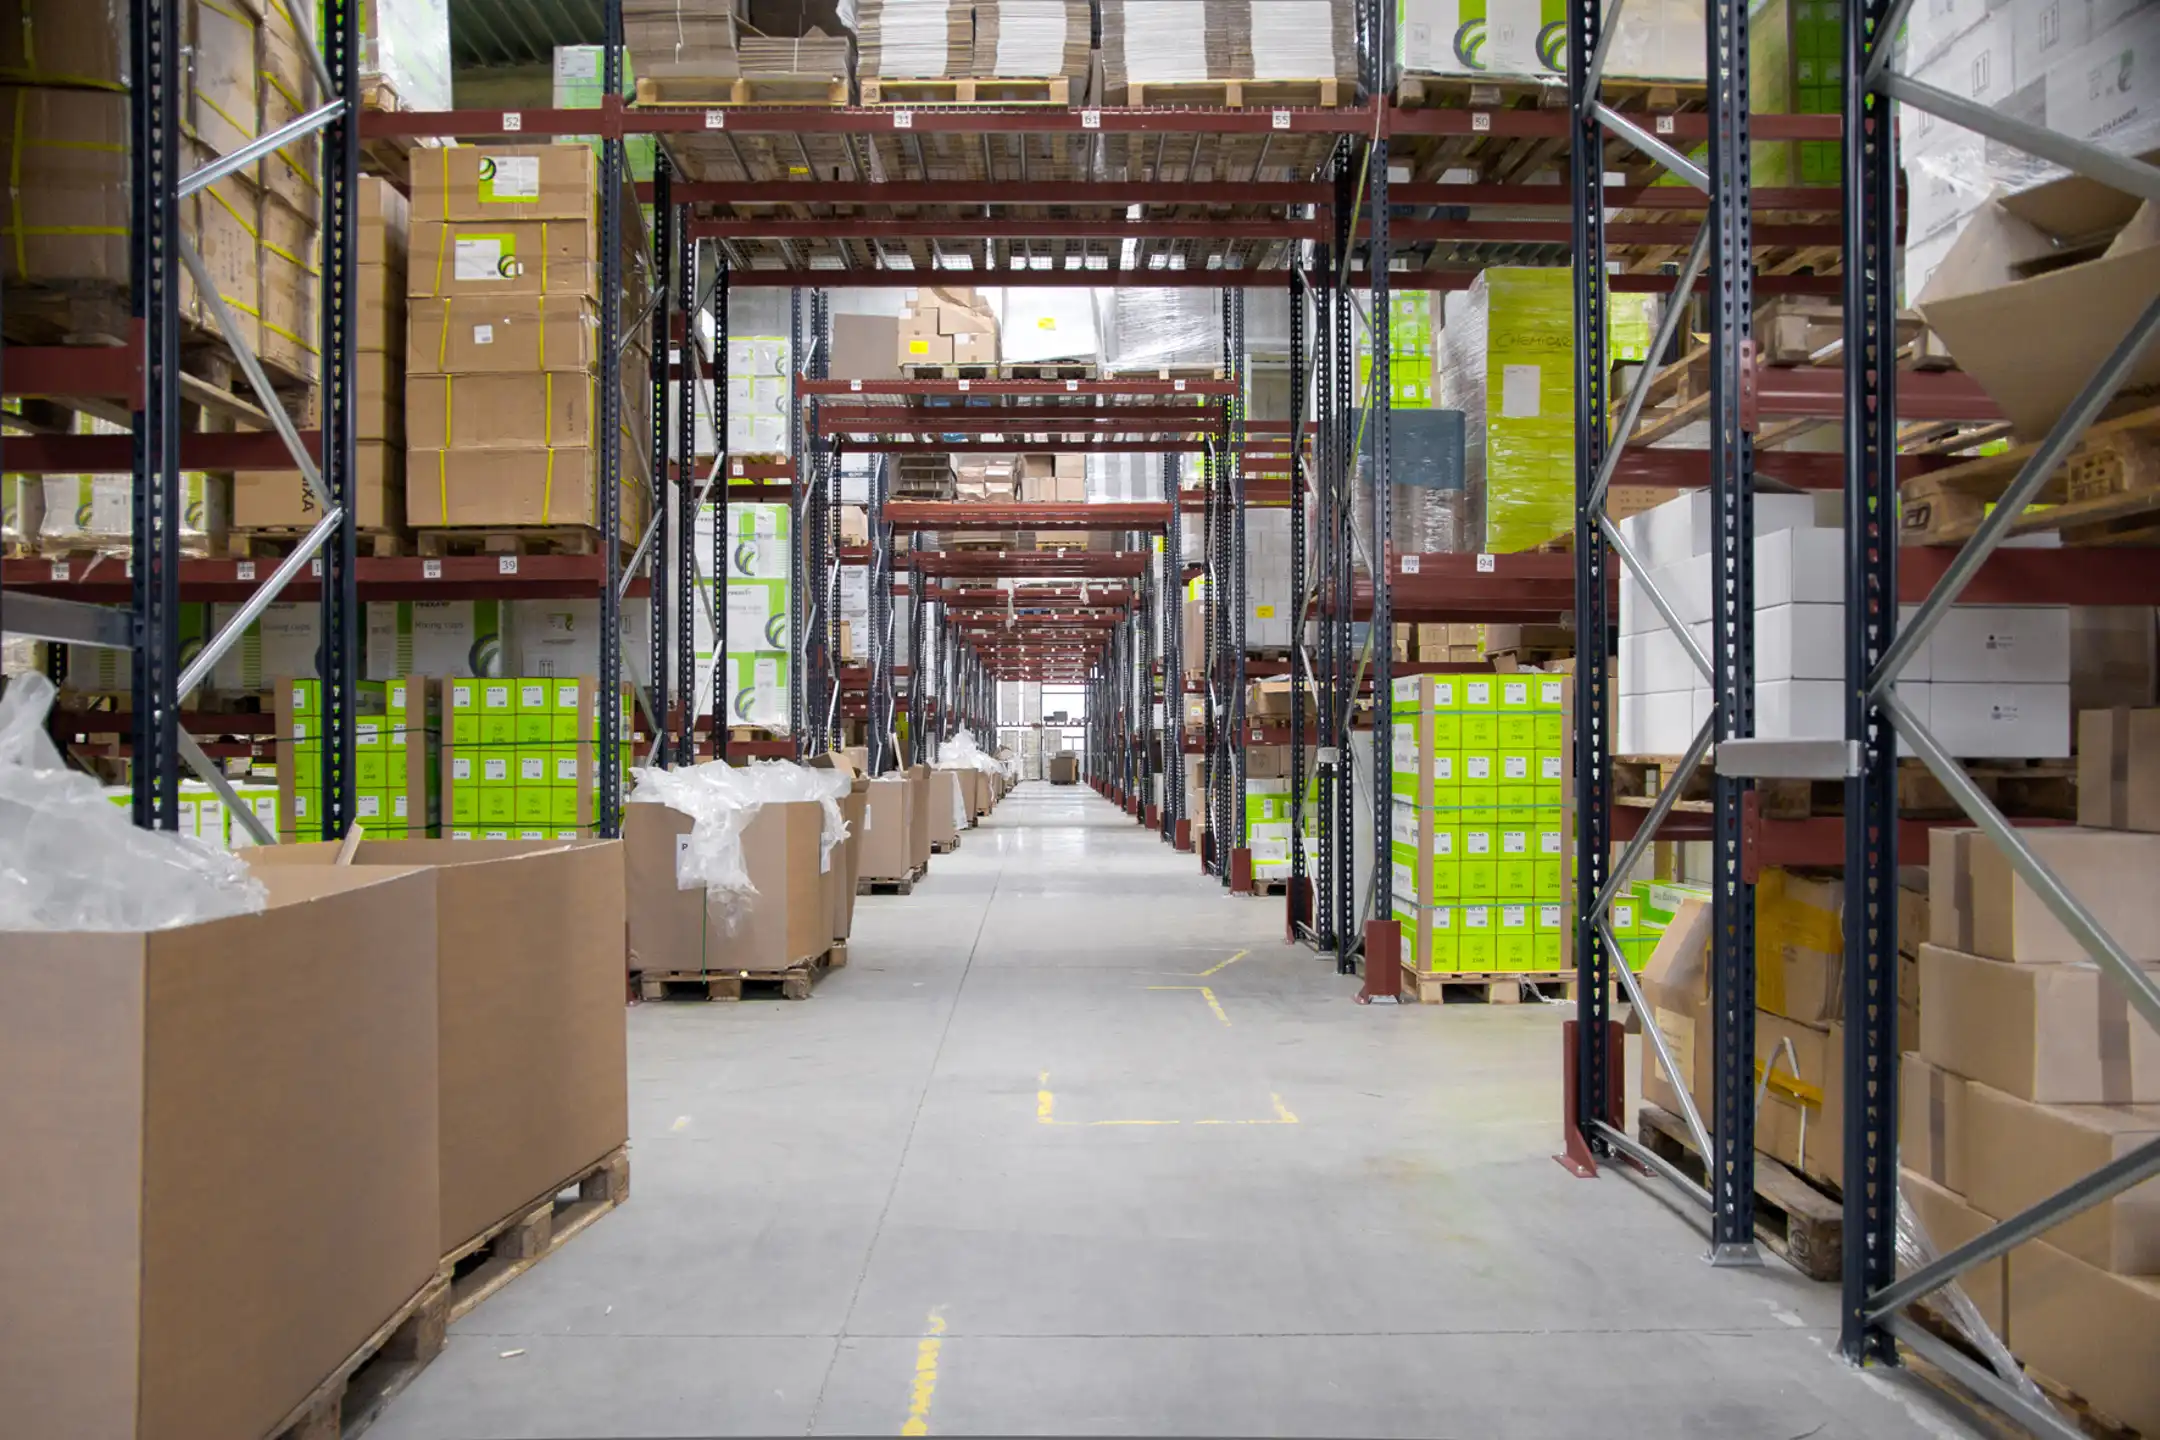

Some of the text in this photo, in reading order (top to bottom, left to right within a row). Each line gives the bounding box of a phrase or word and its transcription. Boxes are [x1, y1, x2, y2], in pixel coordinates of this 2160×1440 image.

[505, 117, 519, 127] 52
[709, 115, 722, 125] 19
[1275, 115, 1288, 125] 55
[1476, 117, 1488, 127] 50
[502, 560, 516, 570] 39
[1479, 559, 1493, 568] 94
